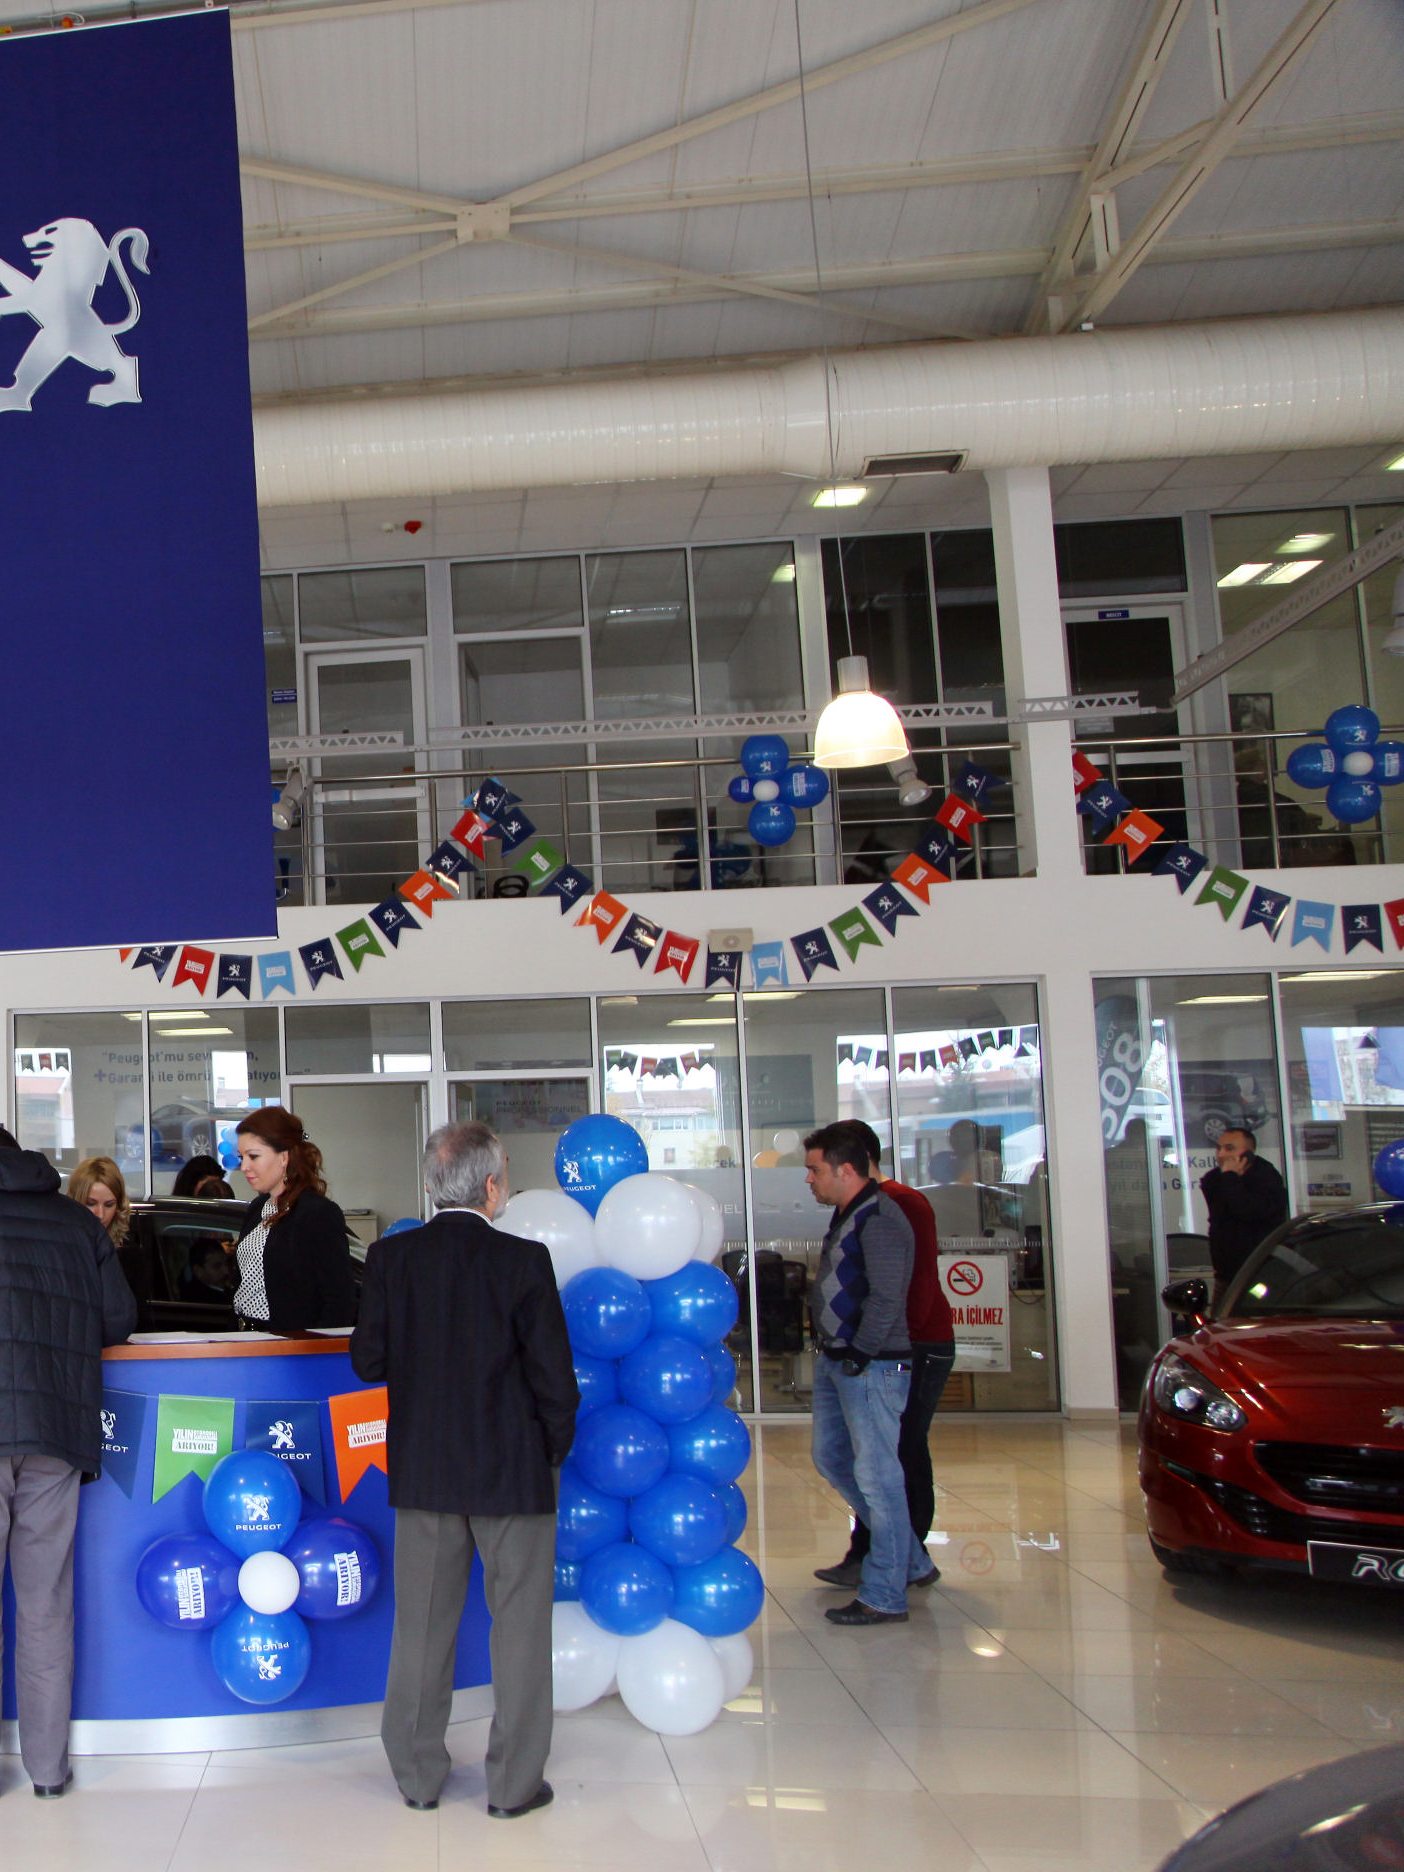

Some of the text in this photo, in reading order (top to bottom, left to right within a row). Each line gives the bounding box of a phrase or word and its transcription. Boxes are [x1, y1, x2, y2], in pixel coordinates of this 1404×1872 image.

[158, 1071, 174, 1082] ile
[966, 1304, 1004, 1327] İÇİLMEZ
[352, 1431, 385, 1446] ARIYOR!
[176, 1441, 214, 1451] ARIYOR!
[235, 1523, 282, 1531] PEUGEOT
[338, 1558, 350, 1602] ARIYOR!
